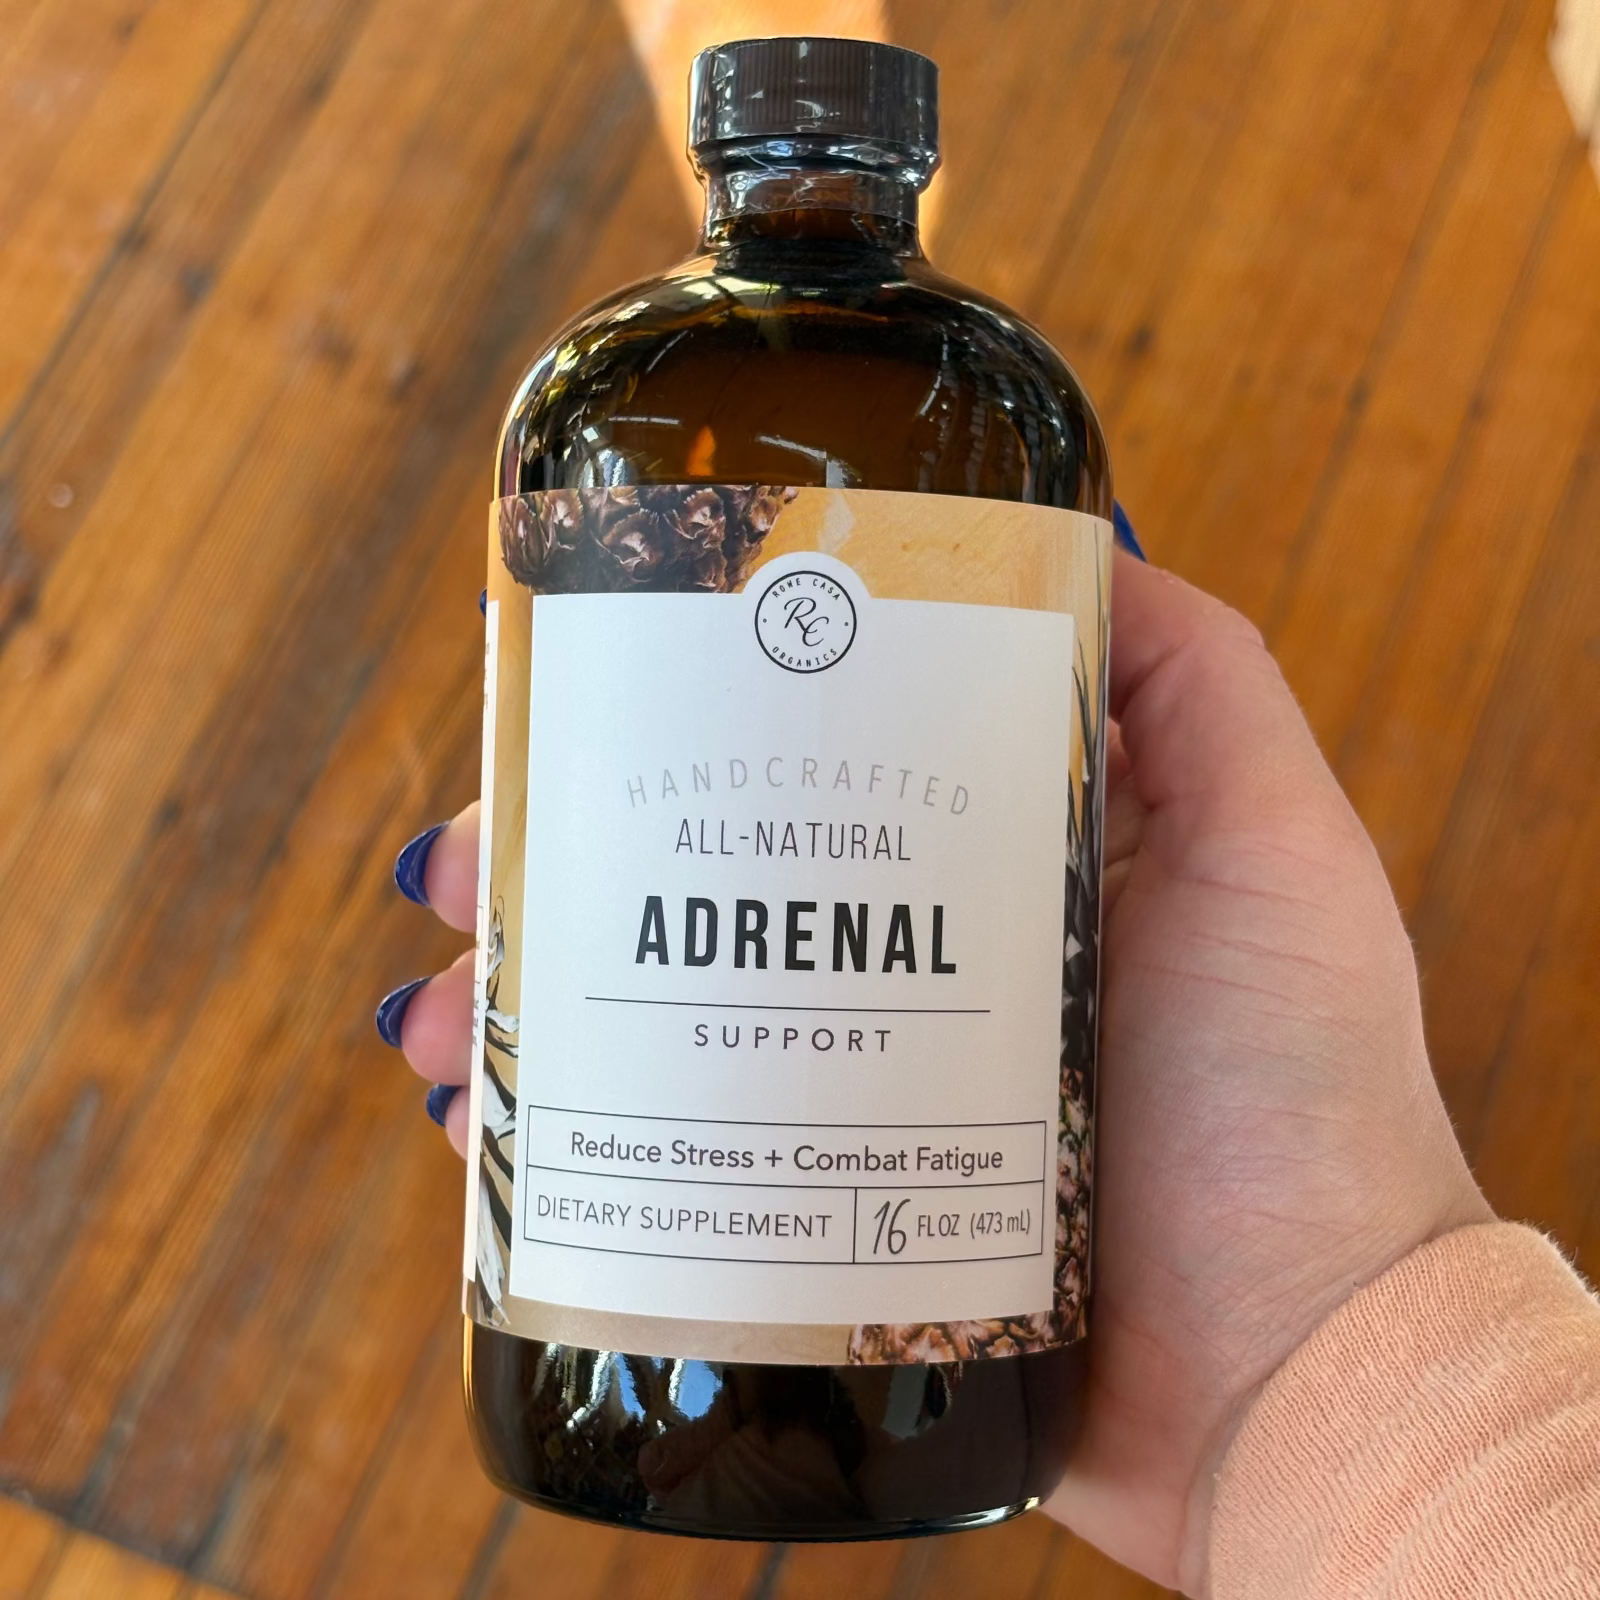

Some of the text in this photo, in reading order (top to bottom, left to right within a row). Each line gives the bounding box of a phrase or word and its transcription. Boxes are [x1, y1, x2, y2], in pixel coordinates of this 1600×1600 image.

[772, 578, 841, 600] ROWE CASA
[772, 646, 837, 668] ORGANICS
[627, 757, 970, 815] HANDCRAFTED
[675, 818, 911, 861] ALL-NATURAL
[635, 895, 956, 974] ADRENAL
[694, 1024, 891, 1052] SUPPORT
[571, 1132, 1003, 1177] Reduce Stress + Combat Fatigue
[537, 1195, 832, 1238] DIETARY SUPPLEMENT
[872, 1199, 911, 1255] 16
[969, 1211, 1003, 1239] (473
